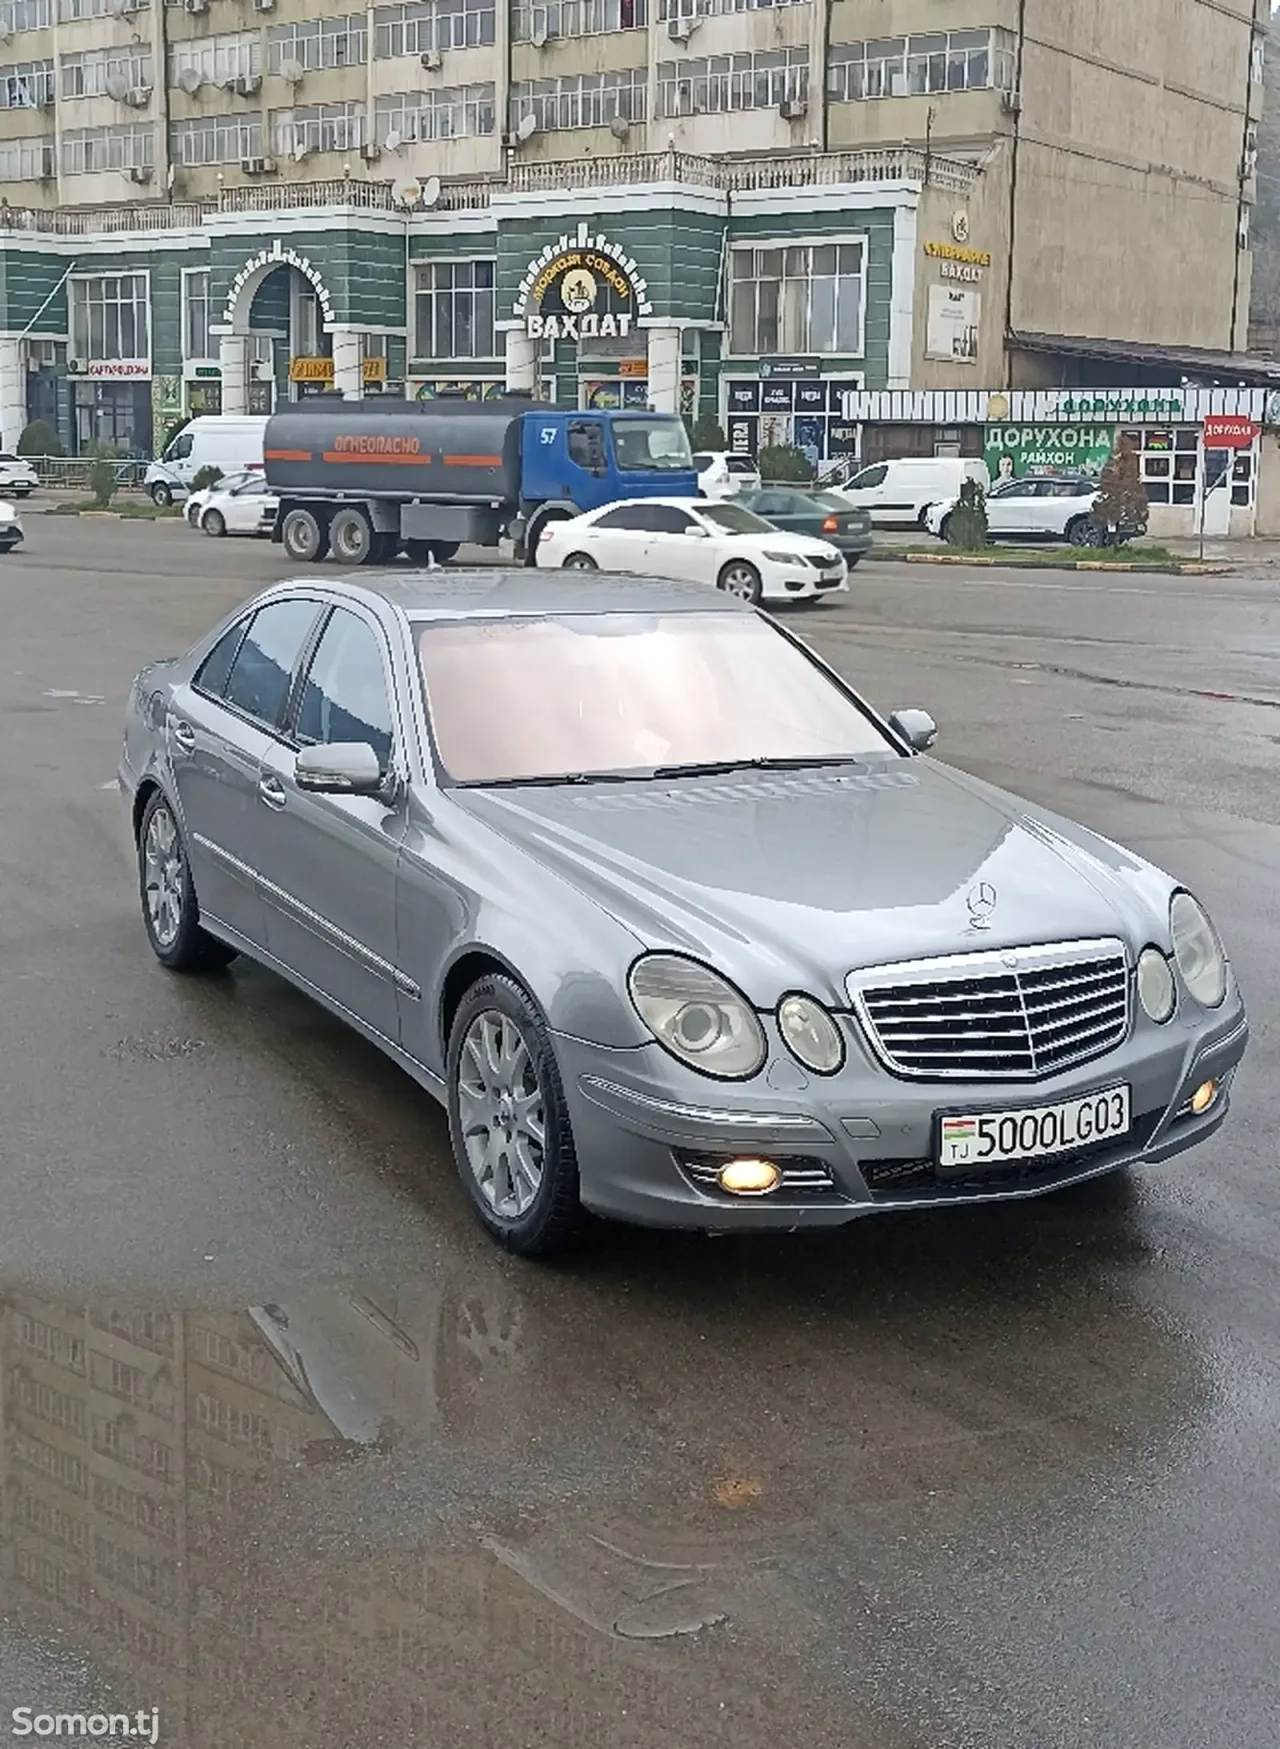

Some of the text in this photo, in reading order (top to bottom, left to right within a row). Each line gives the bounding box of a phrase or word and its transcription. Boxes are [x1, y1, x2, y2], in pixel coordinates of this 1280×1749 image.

[334, 435, 421, 454] ОГНЕОПАСНО
[540, 428, 557, 444] 57
[986, 428, 1110, 451] ДОРУХОНА
[1020, 448, 1074, 464] РАЙХОН
[977, 1093, 1124, 1157] 5000LG03
[951, 1144, 969, 1159] TJ
